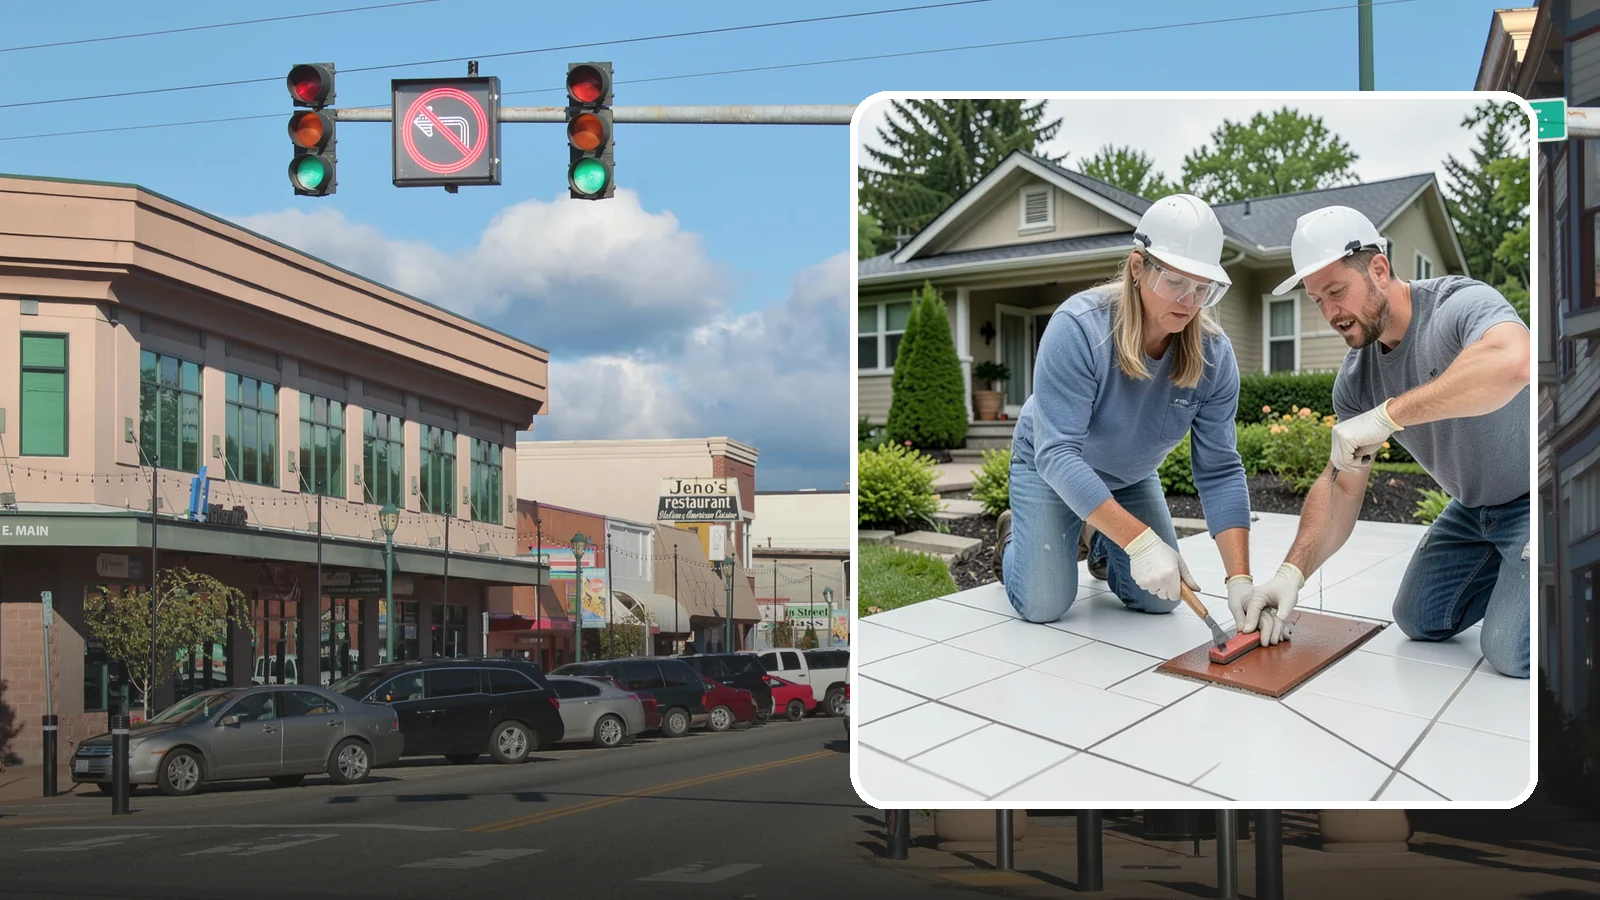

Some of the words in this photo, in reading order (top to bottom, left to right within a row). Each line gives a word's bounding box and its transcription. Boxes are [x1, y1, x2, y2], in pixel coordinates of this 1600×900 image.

[669, 480, 727, 494] Jeno's
[665, 496, 731, 509] restaurant
[658, 510, 682, 519] Italian
[686, 509, 714, 519] American
[715, 509, 738, 519] Cuisine
[2, 525, 13, 536] E.
[15, 525, 49, 536] MAIN
[786, 607, 795, 616] in
[797, 608, 828, 616] Street
